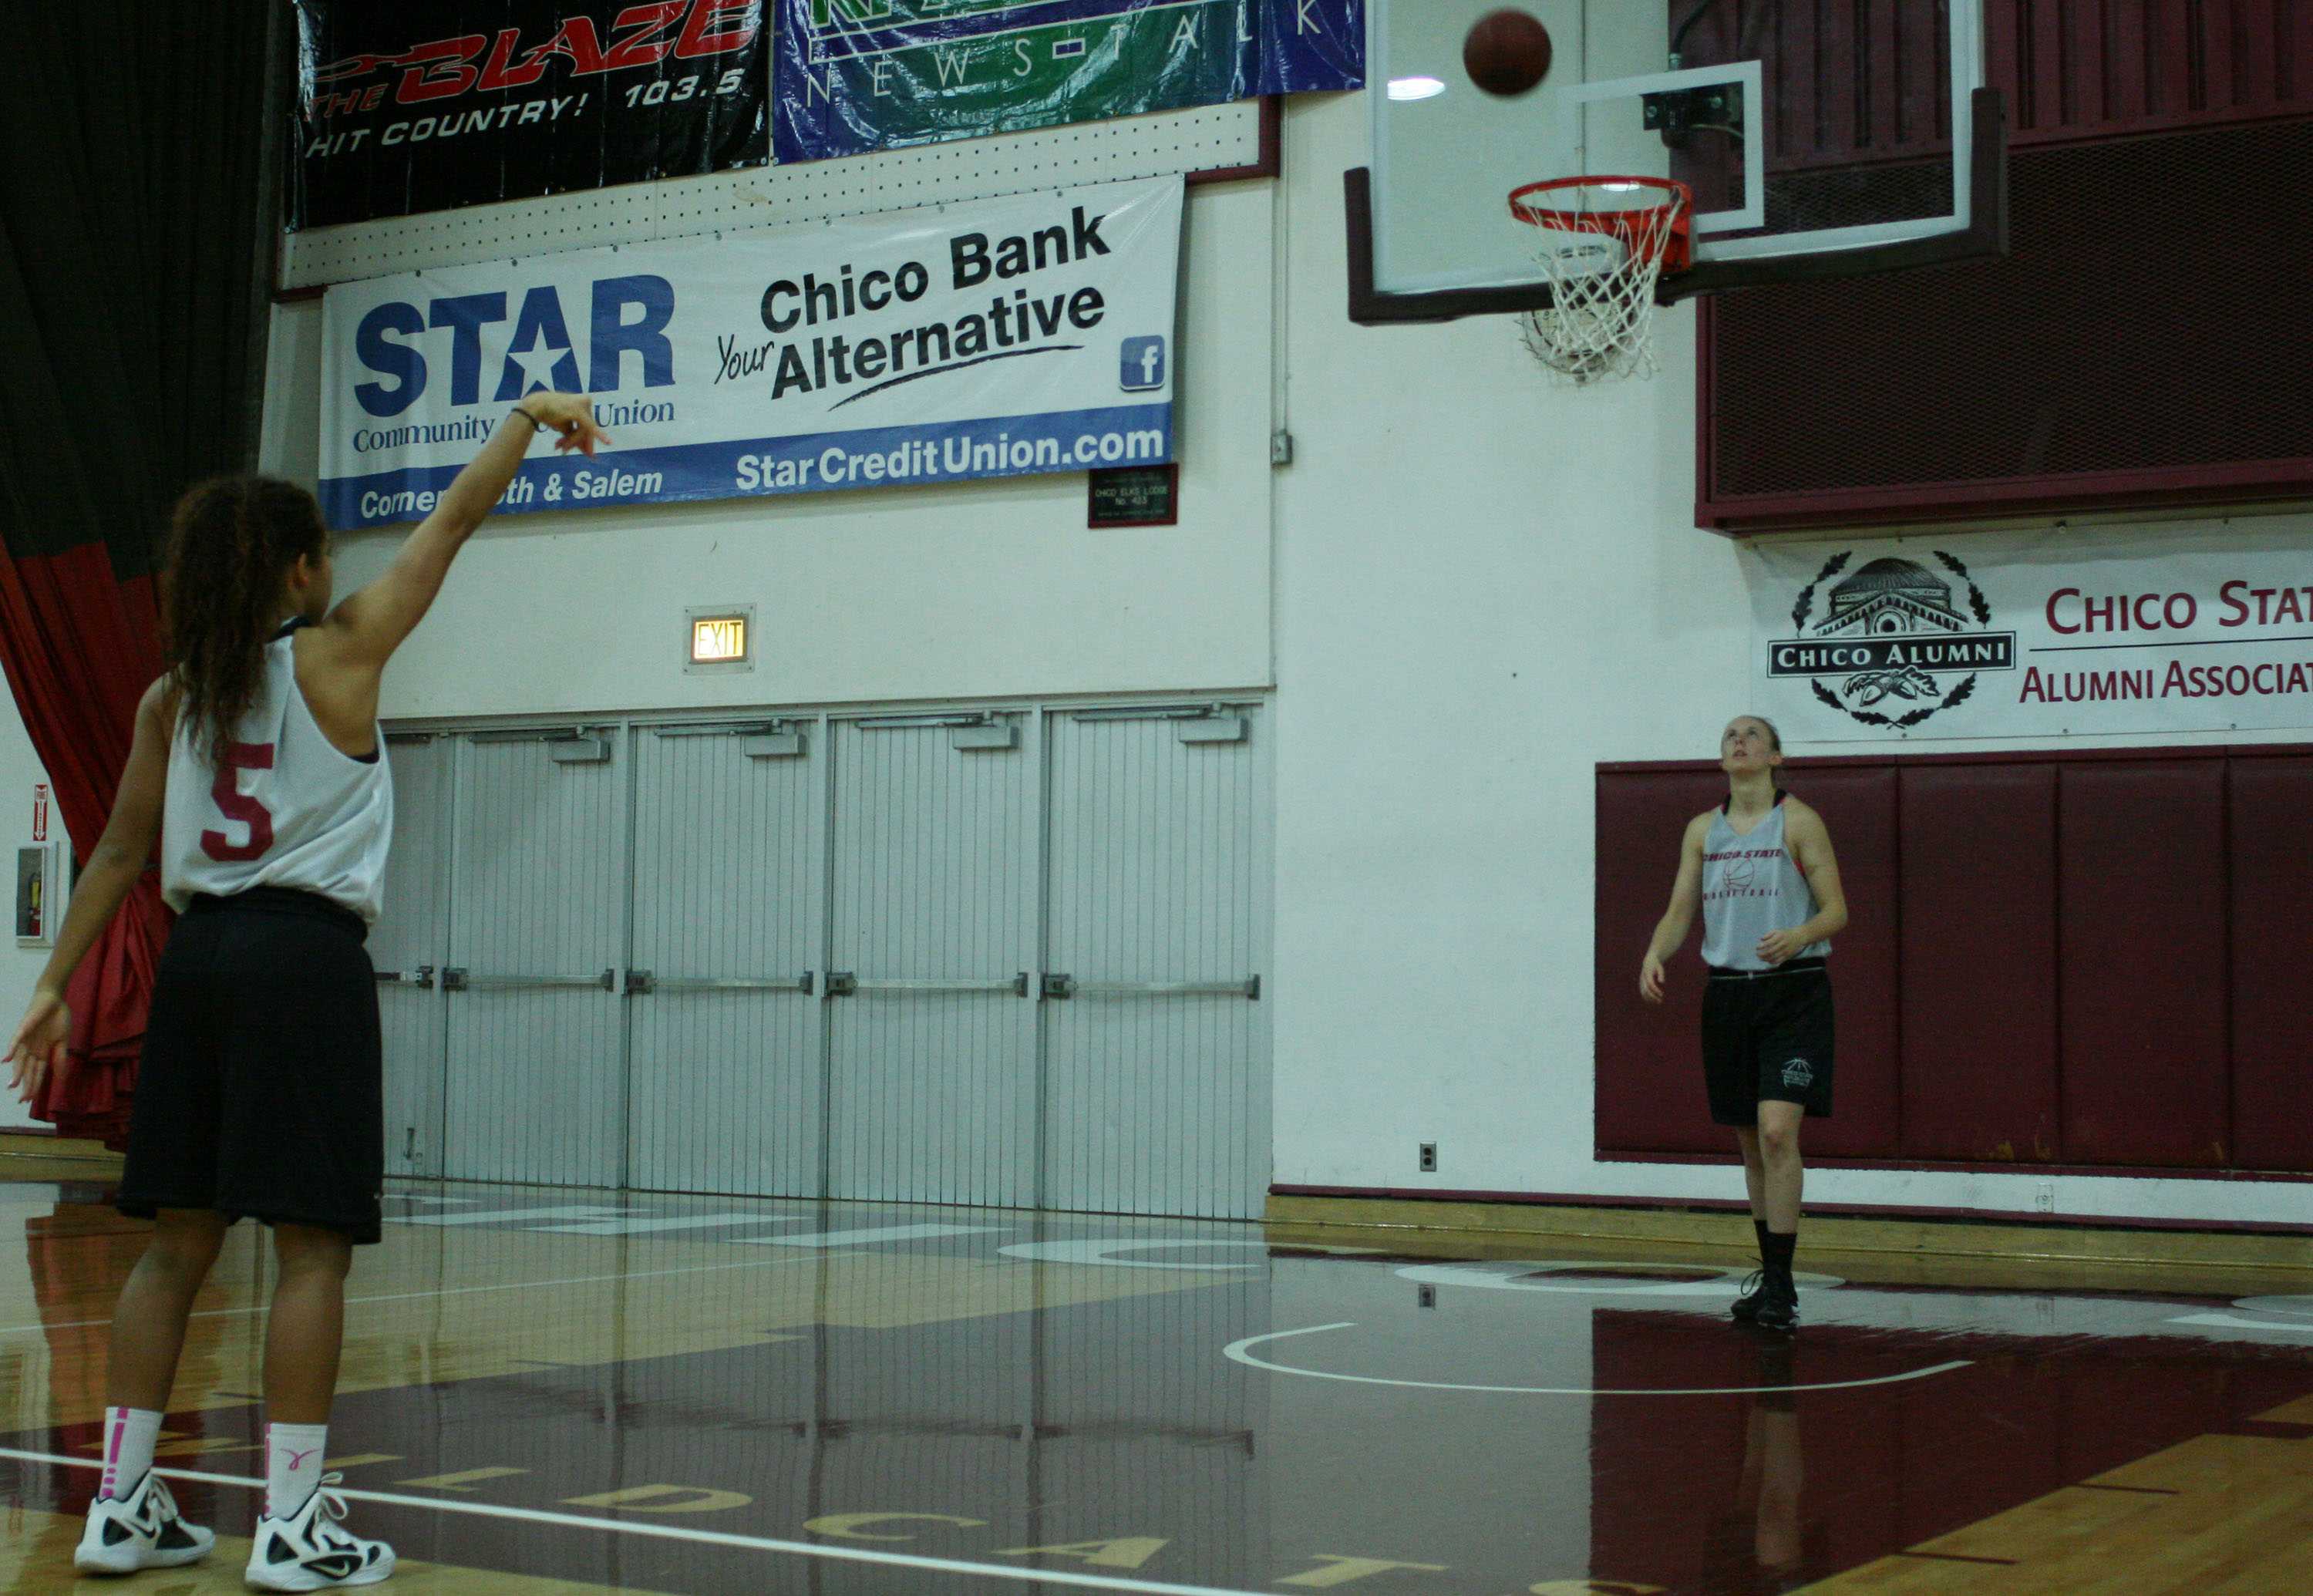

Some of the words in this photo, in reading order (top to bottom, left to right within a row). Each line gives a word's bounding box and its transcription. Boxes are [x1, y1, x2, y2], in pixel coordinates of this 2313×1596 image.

[305, 83, 389, 122] THE
[394, 0, 763, 104] BLAZE
[305, 129, 371, 158] HIT
[381, 93, 590, 146] COUNTRY!
[625, 68, 746, 108] 103.5
[760, 264, 929, 334] Chico
[948, 205, 1111, 291] Bank
[354, 274, 676, 418] STAR
[714, 334, 775, 385] Your
[771, 285, 1106, 400] Alternative
[353, 415, 495, 453] Community
[594, 400, 675, 429] Union
[496, 475, 535, 506] th
[543, 473, 564, 502] &
[571, 468, 663, 500] Salem
[735, 428, 1164, 491] StarCreditUnion.com
[698, 621, 742, 656] EXIT
[2045, 587, 2198, 635] CHICO
[1777, 646, 1871, 669] CHICO
[1886, 641, 2006, 664] ALUMNI
[2018, 665, 2153, 703] ALUMNI
[199, 741, 274, 862] 5
